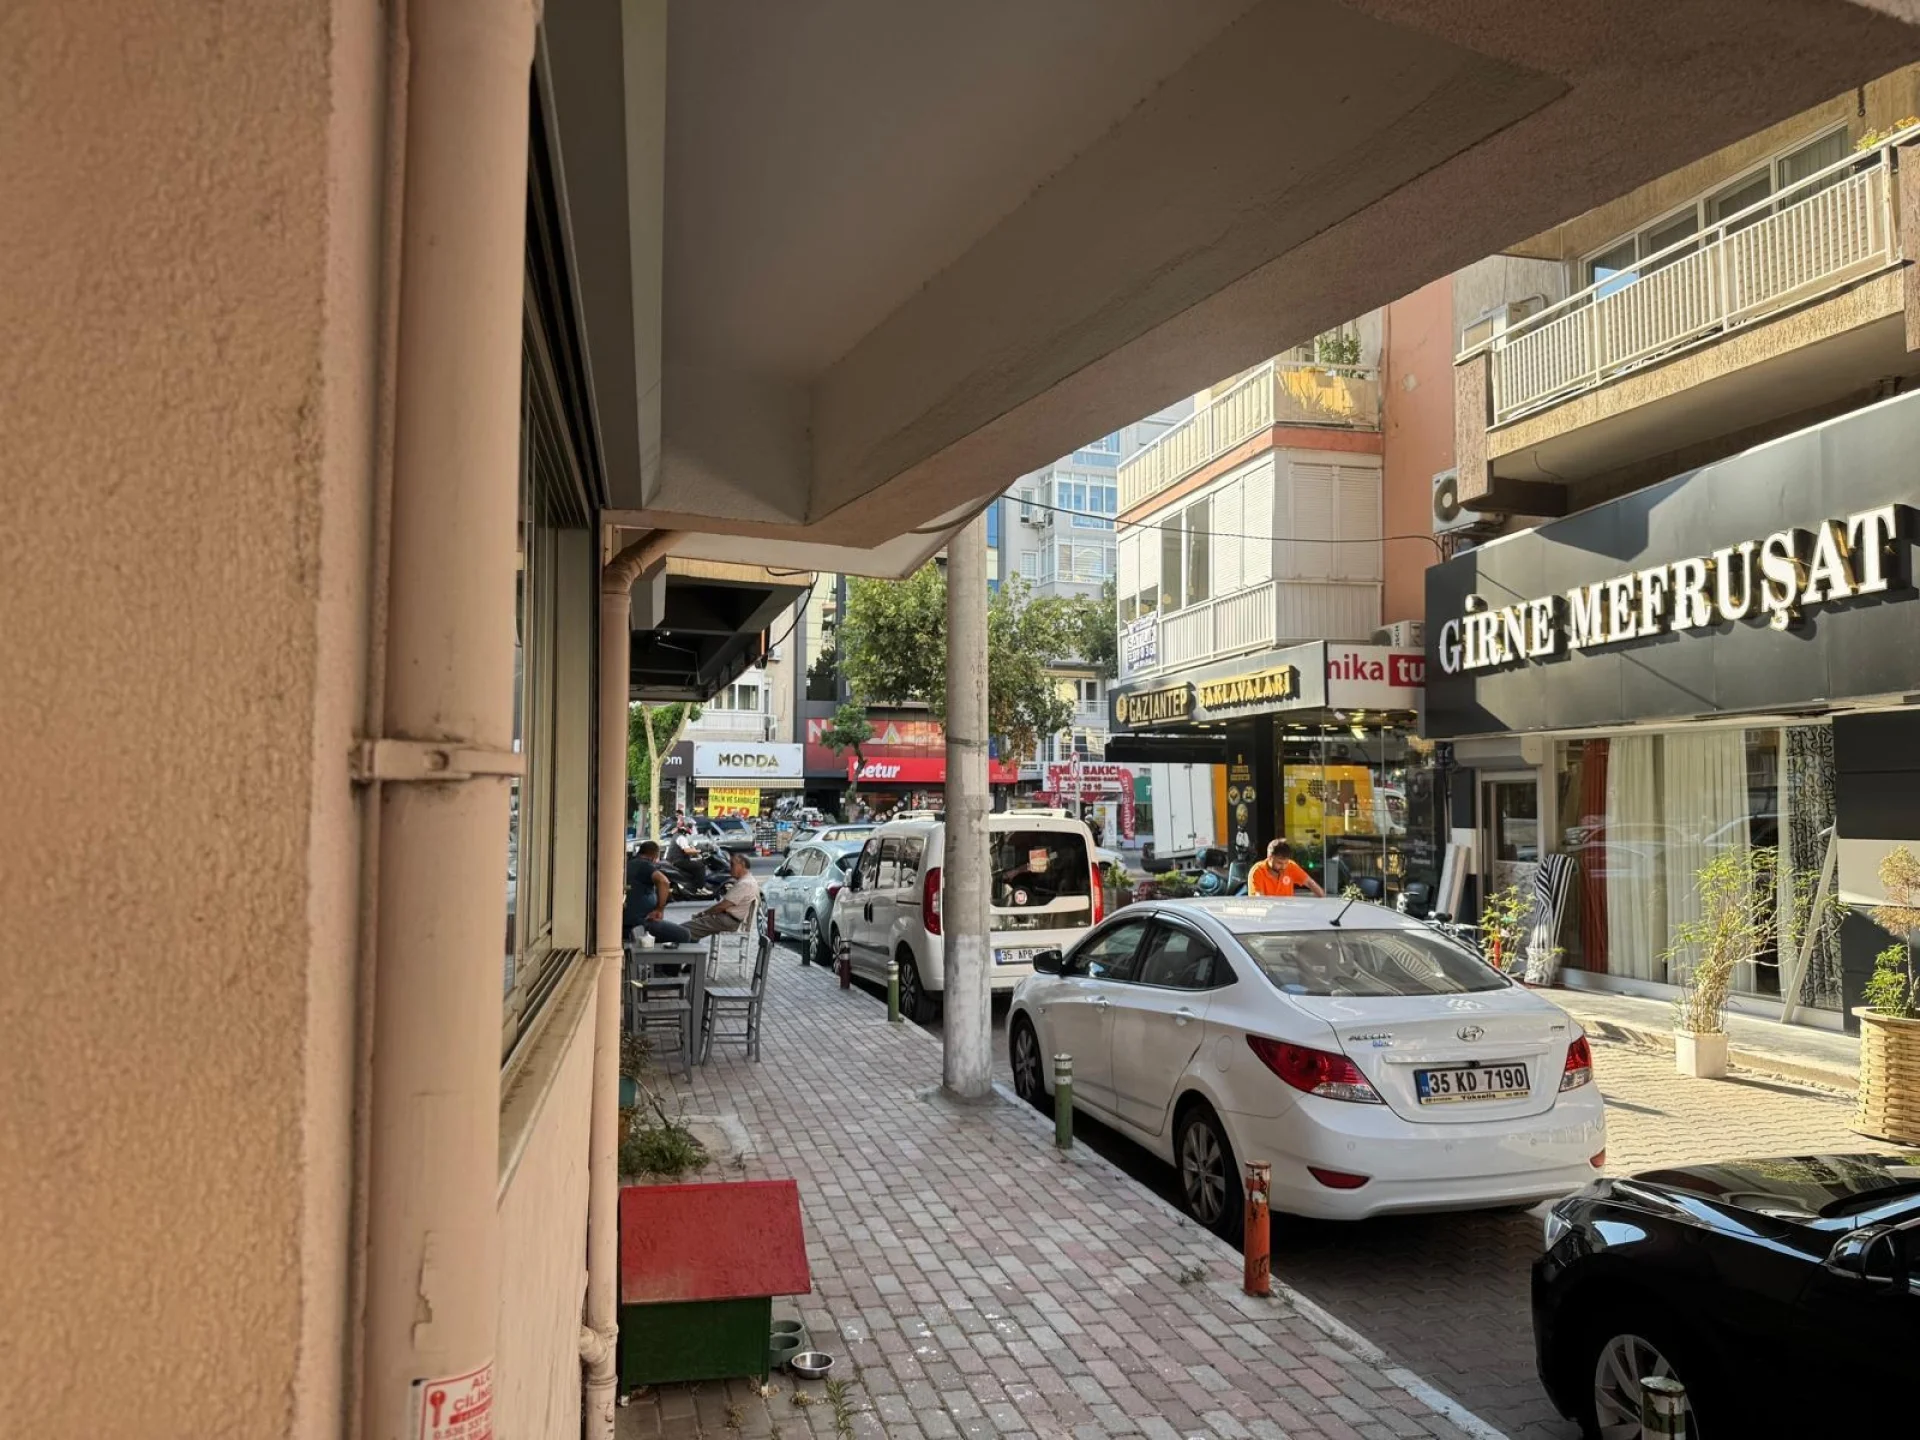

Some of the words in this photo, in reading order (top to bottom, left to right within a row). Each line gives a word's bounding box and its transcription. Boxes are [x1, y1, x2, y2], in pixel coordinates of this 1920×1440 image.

[1439, 594, 1555, 674] GİRNE
[1566, 503, 1897, 631] MEFRUŞAT
[718, 753, 779, 767] MODDA
[1429, 1073, 1450, 1093] 35
[1455, 1072, 1477, 1092] KD
[1483, 1068, 1524, 1090] 7190
